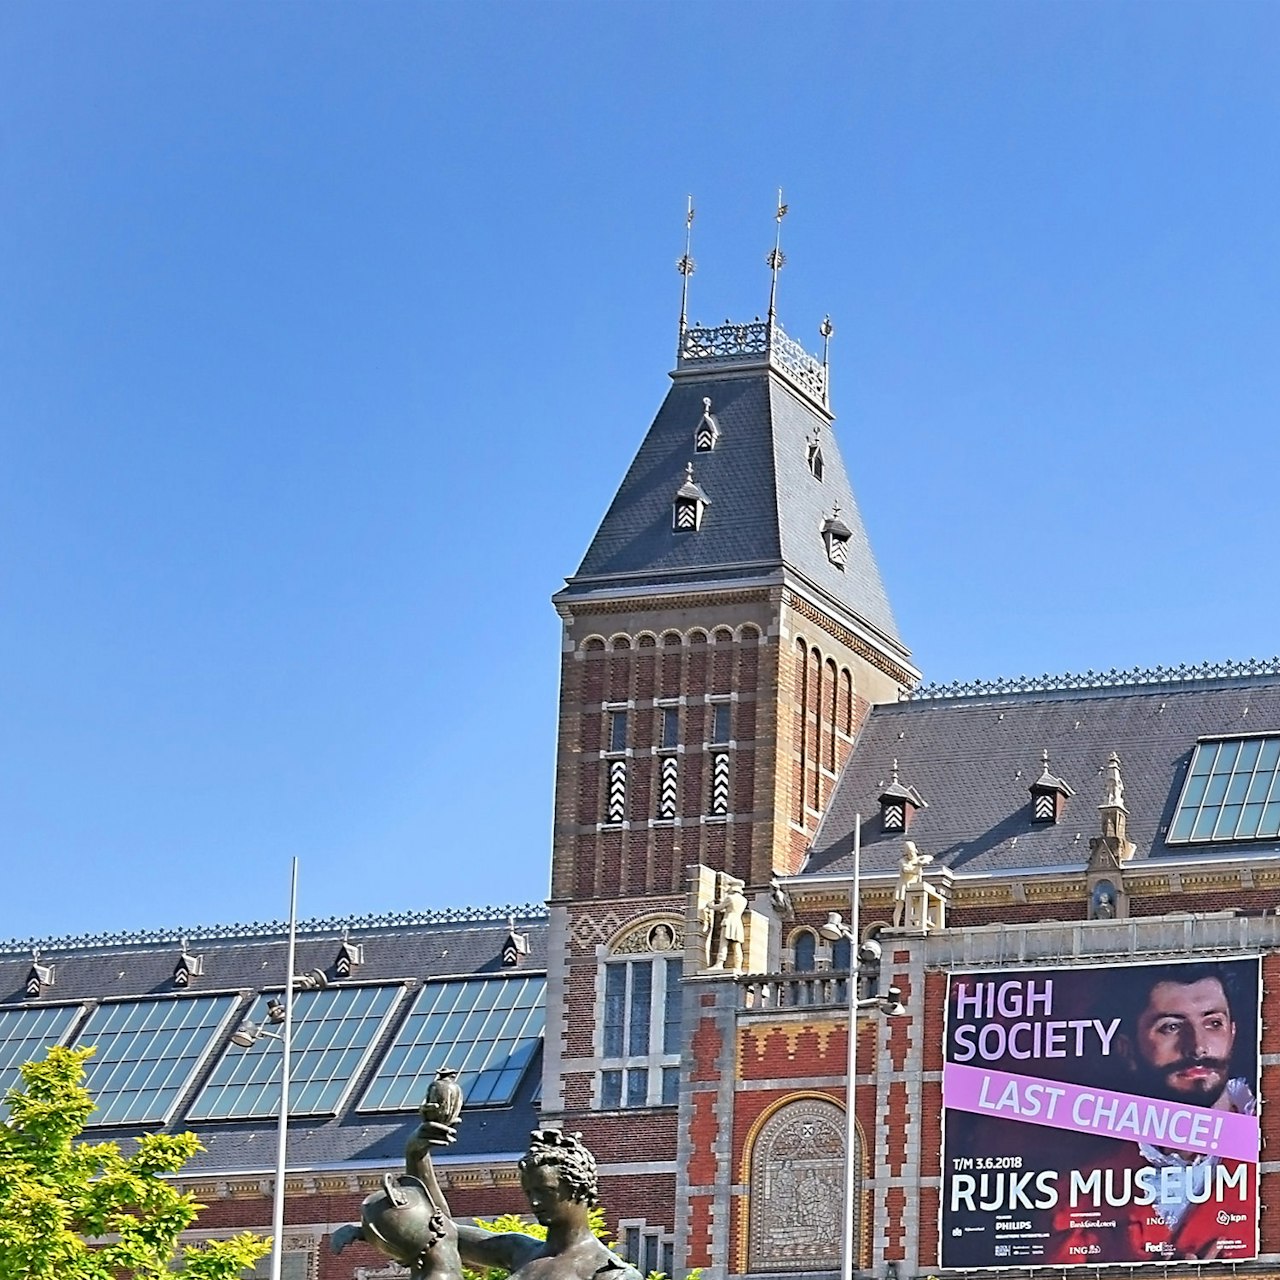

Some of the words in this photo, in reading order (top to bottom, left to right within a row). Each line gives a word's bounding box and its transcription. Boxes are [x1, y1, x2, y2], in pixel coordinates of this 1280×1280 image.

[956, 979, 1053, 1020] HIGH
[953, 1018, 1122, 1062] SOCIETY
[978, 1076, 1066, 1121] LAST
[1072, 1093, 1224, 1150] CHANCE!
[952, 1158, 974, 1171] T/M
[975, 1156, 1023, 1170] 3.6.2018
[950, 1170, 1059, 1212] RIJKS
[1069, 1163, 1248, 1208] MUSEUM
[995, 1220, 1032, 1231] PHILIPS
[1146, 1217, 1166, 1226] ING
[1230, 1213, 1248, 1223] kpn
[1069, 1246, 1088, 1255] ING
